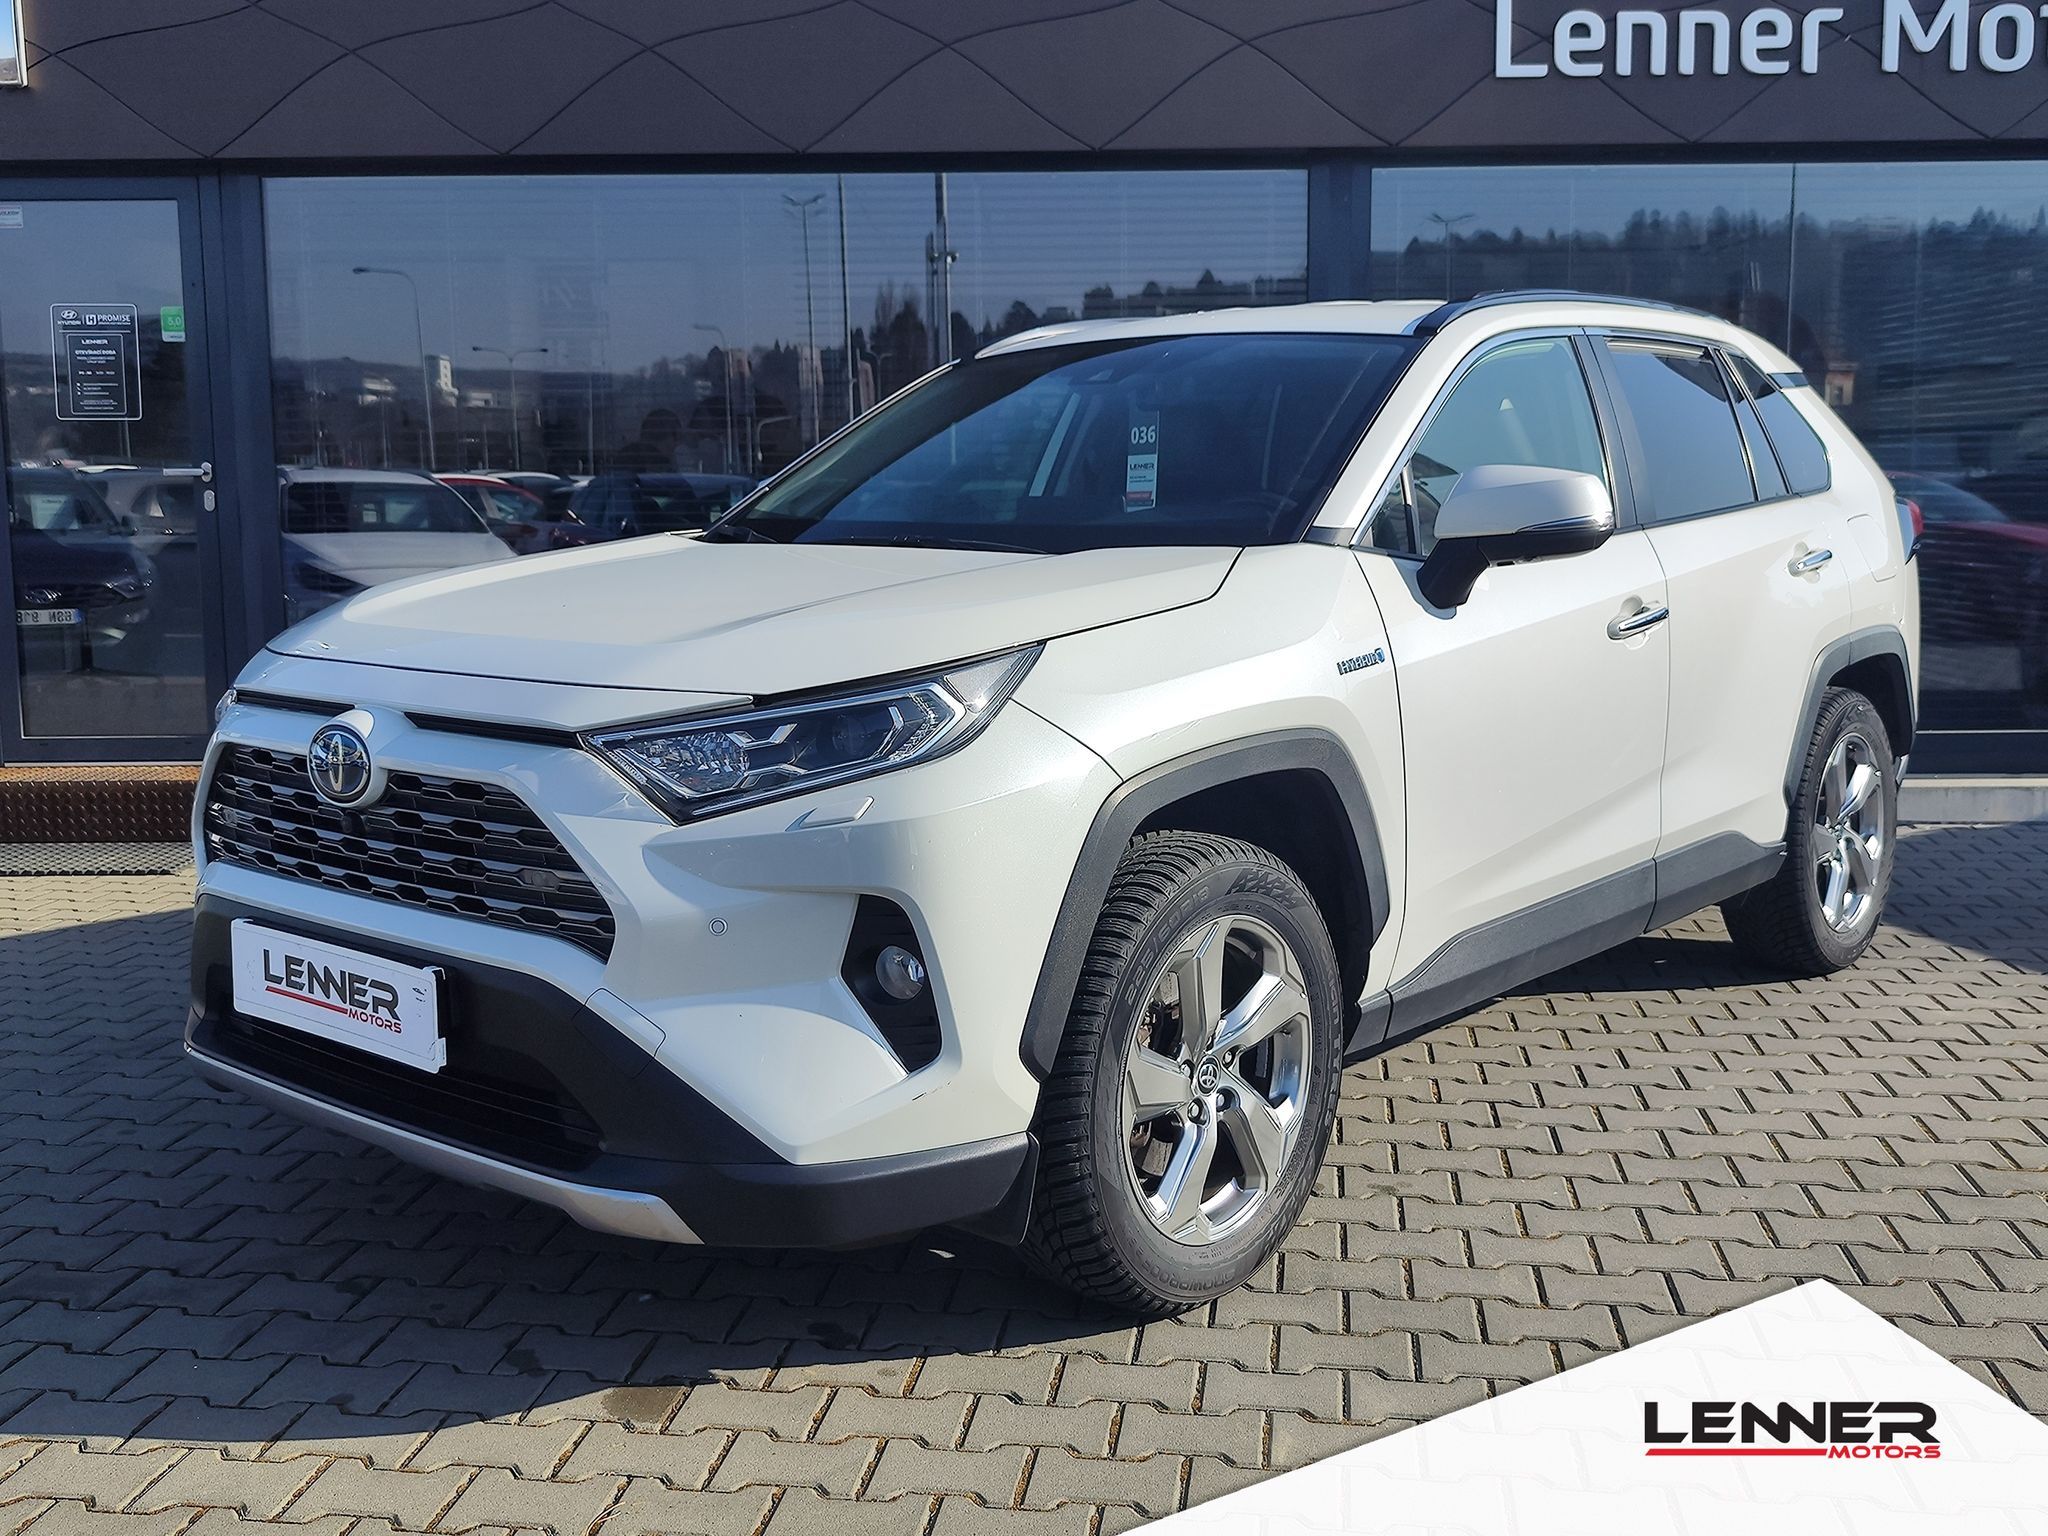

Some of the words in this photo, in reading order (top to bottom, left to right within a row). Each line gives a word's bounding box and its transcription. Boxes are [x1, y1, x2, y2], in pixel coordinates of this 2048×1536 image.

[1495, 0, 1844, 77] Lenner
[1881, 0, 2048, 74] Mo
[97, 314, 131, 322] PROMISE
[1131, 425, 1156, 444] 036
[263, 949, 402, 1021] LENNER
[348, 1007, 402, 1034] MOTORS
